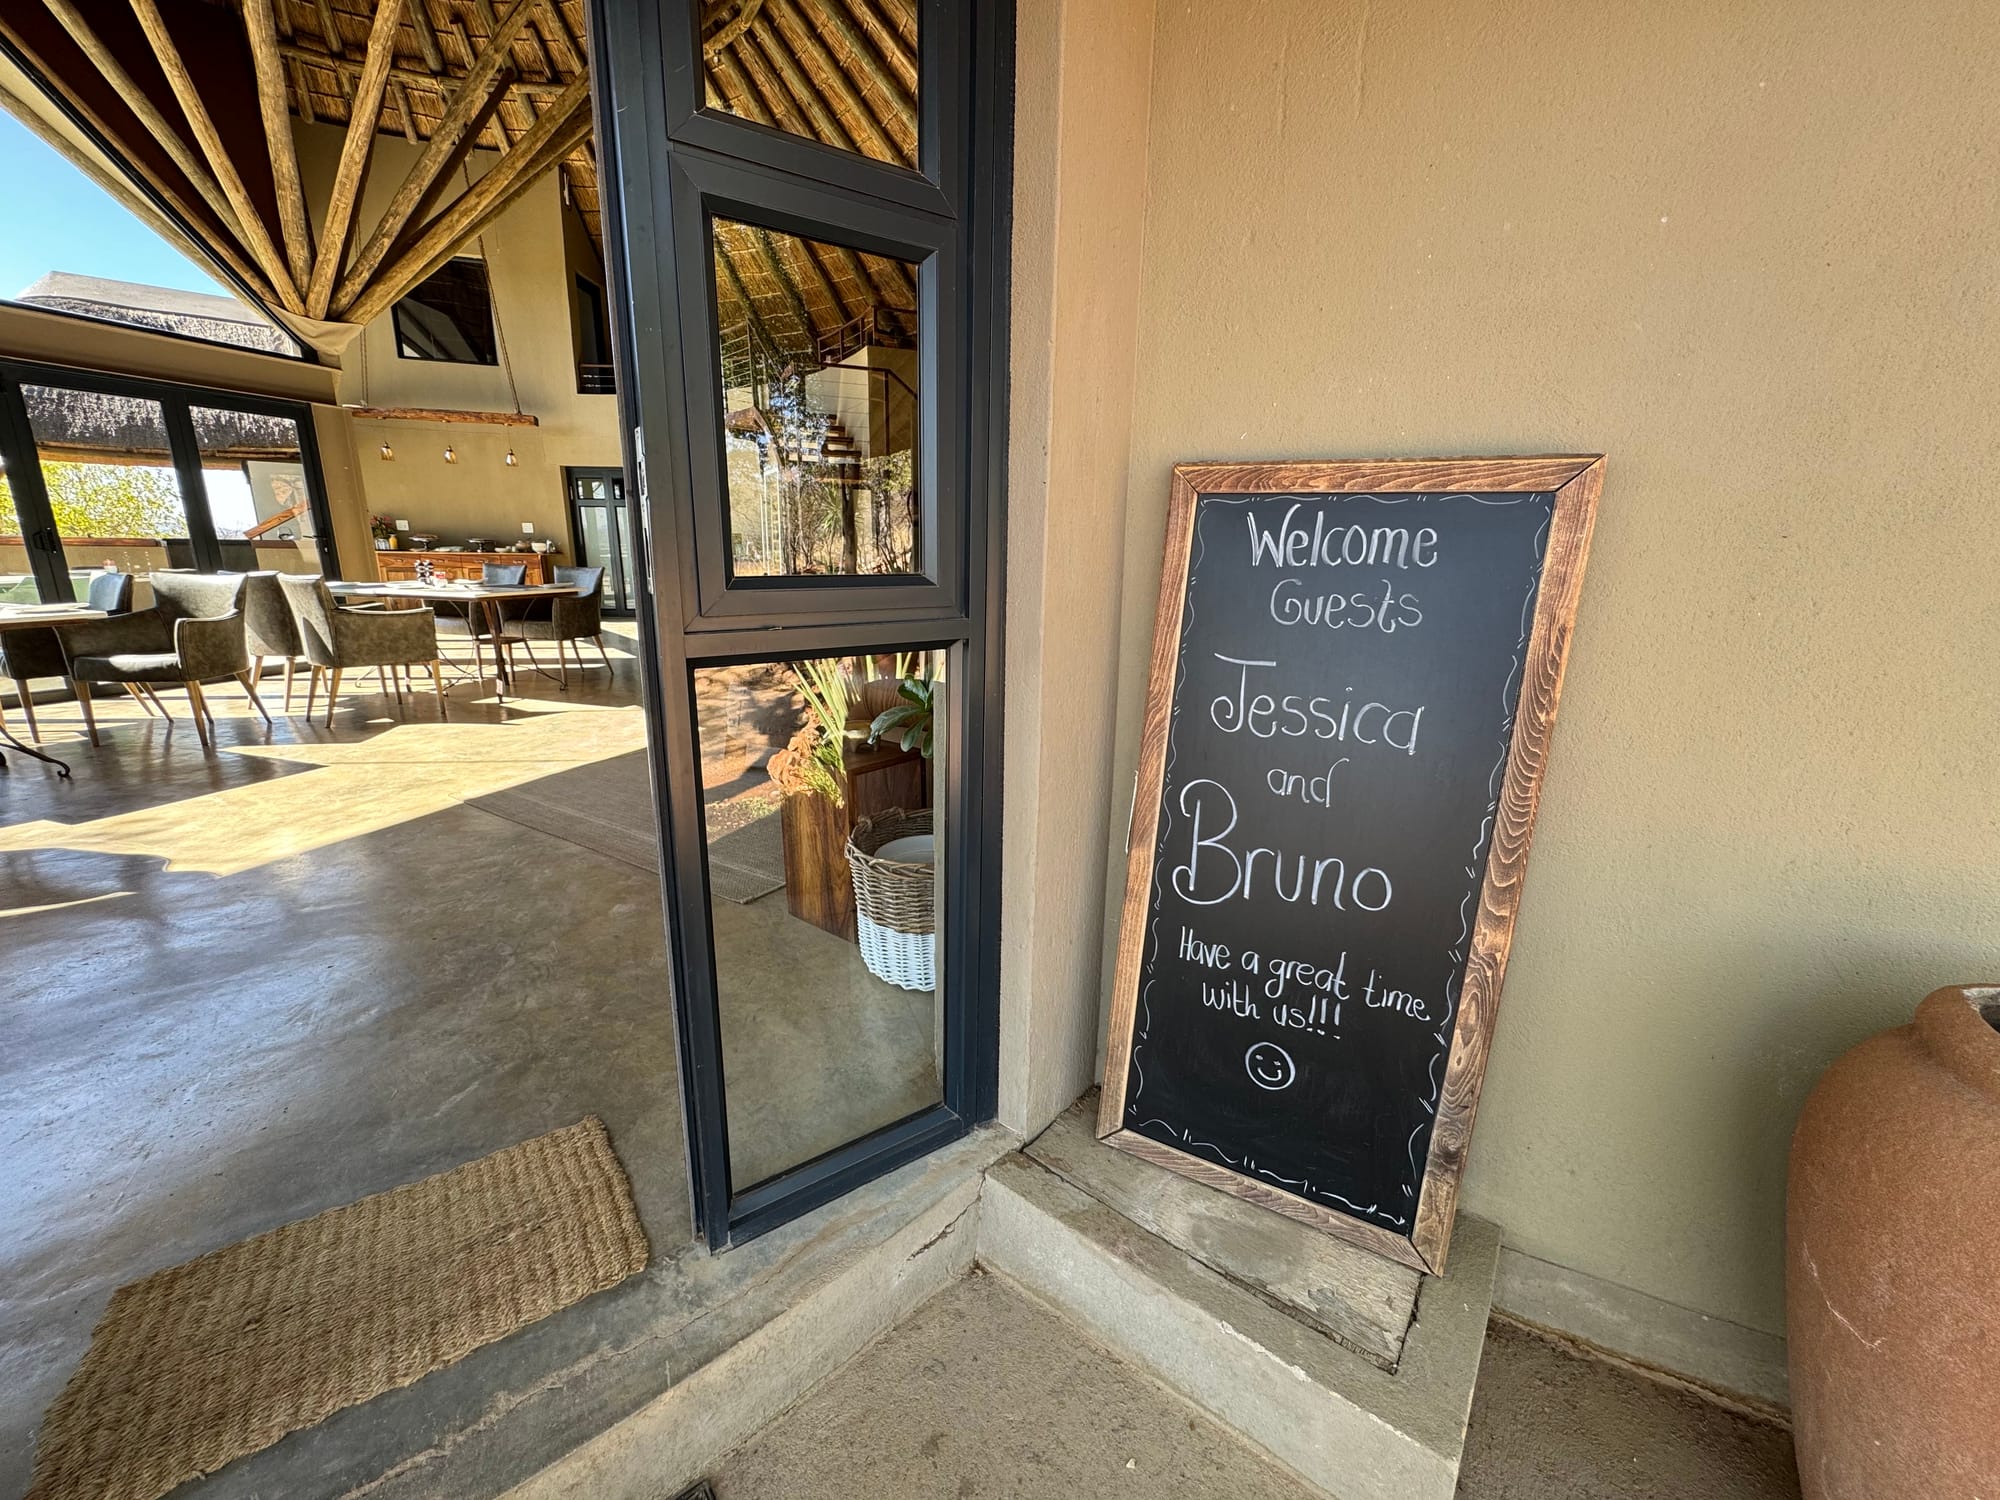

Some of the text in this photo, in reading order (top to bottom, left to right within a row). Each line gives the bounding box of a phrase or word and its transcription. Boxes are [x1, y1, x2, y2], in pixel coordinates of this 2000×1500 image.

[1246, 503, 1439, 569] Welcome
[1269, 578, 1423, 633] Guests
[1210, 652, 1425, 755] Jessica
[1266, 757, 1350, 808] and
[1171, 778, 1393, 912] Bruno
[1178, 925, 1431, 1022] Have a great time
[1202, 979, 1341, 1040] with us!!!
